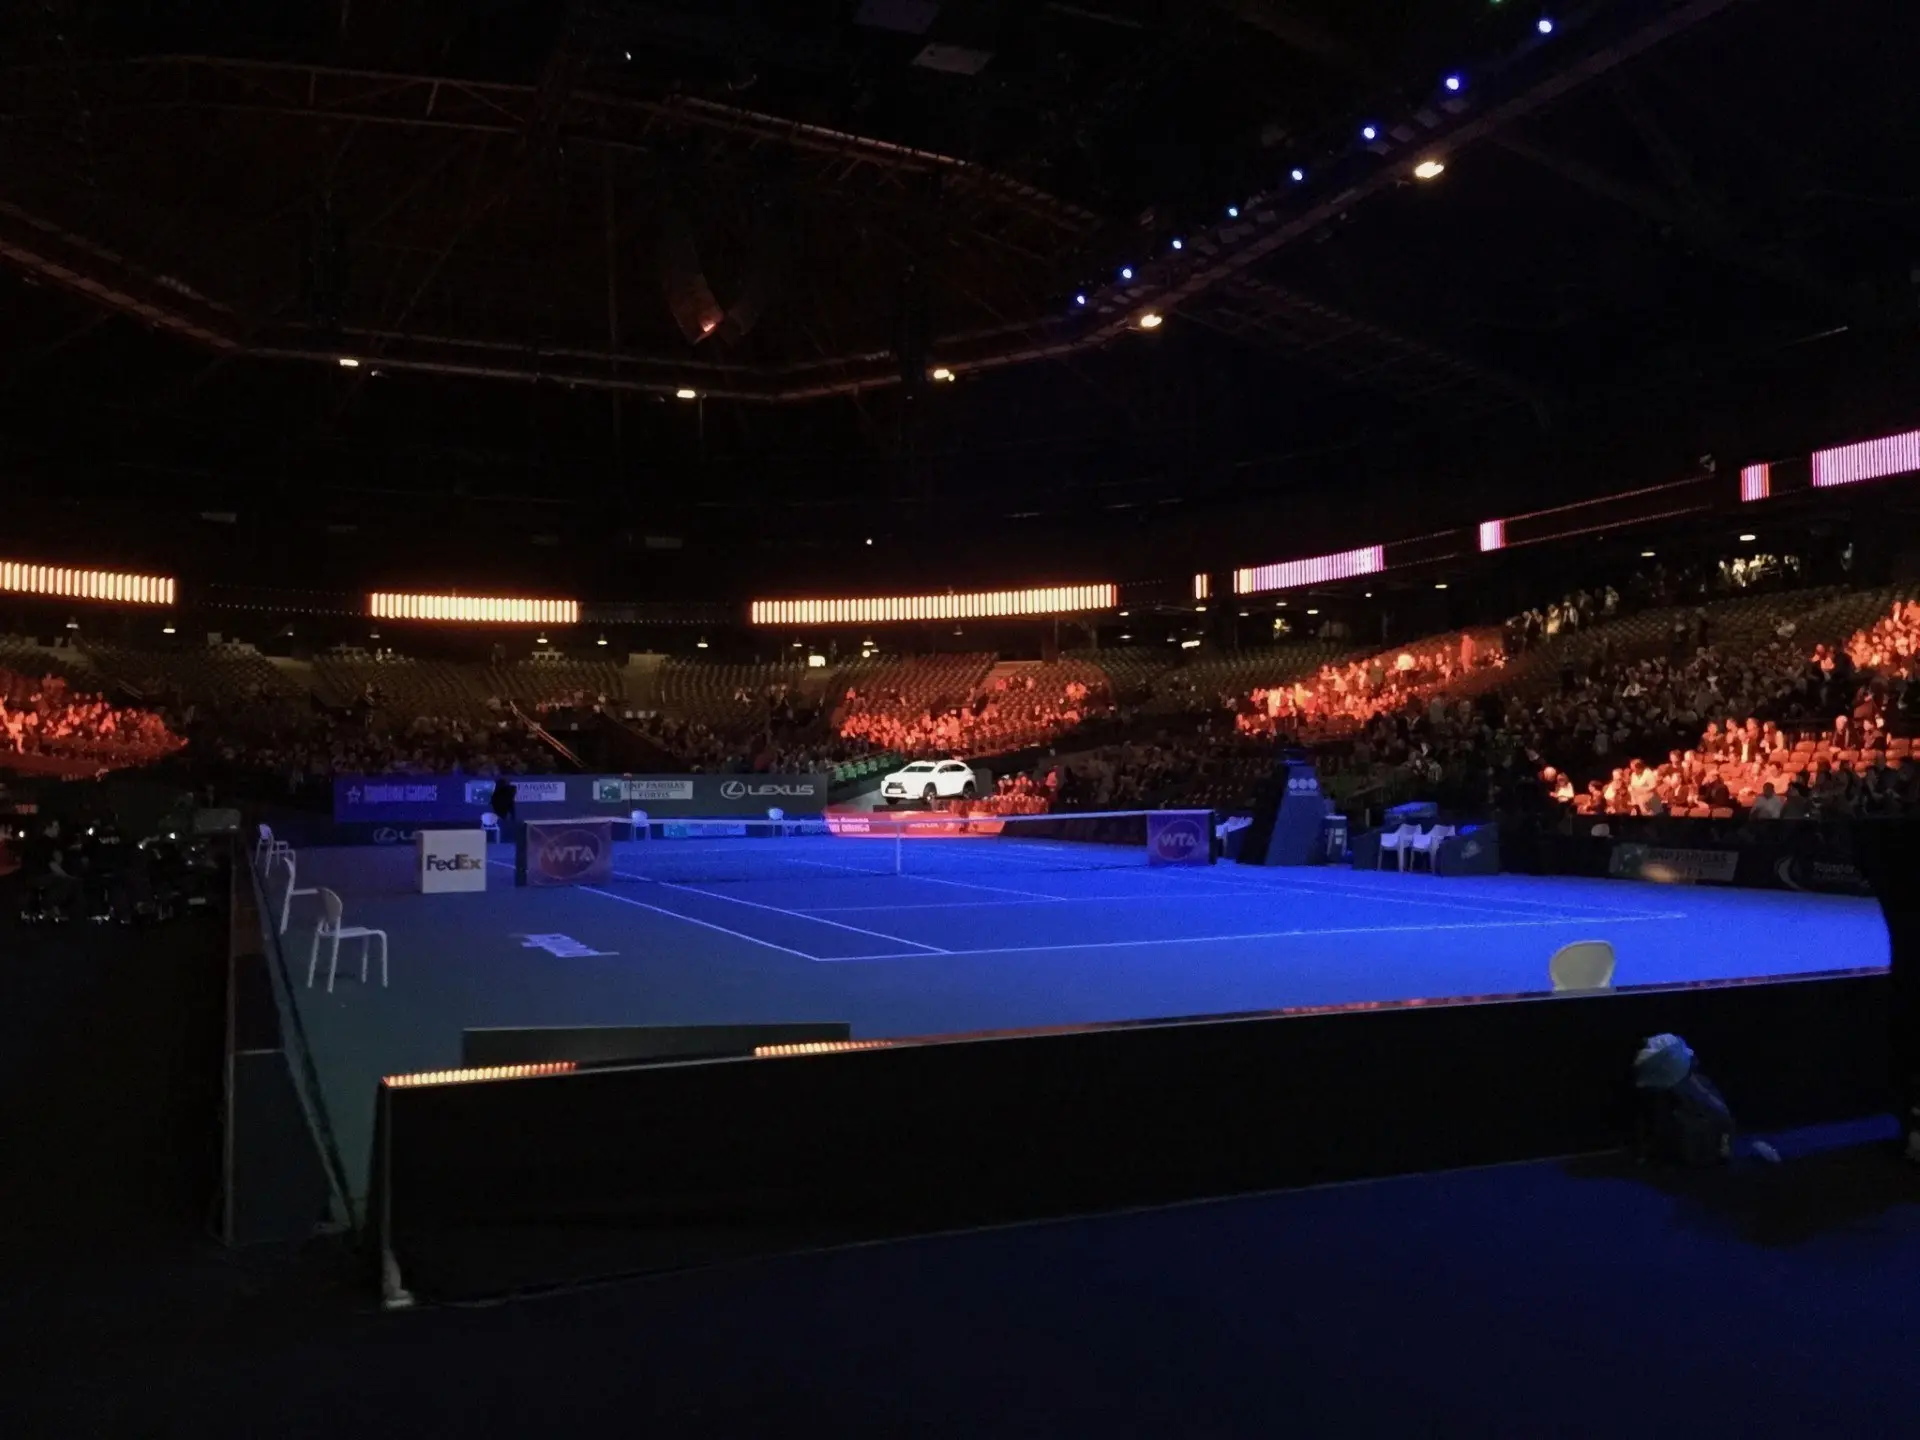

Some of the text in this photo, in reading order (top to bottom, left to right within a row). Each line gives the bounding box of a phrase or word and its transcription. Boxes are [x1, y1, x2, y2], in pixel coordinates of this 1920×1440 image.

[747, 783, 815, 796] LEXUS
[1161, 834, 1198, 848] WTA
[547, 845, 596, 863] WTA
[426, 853, 482, 872] FedEx
